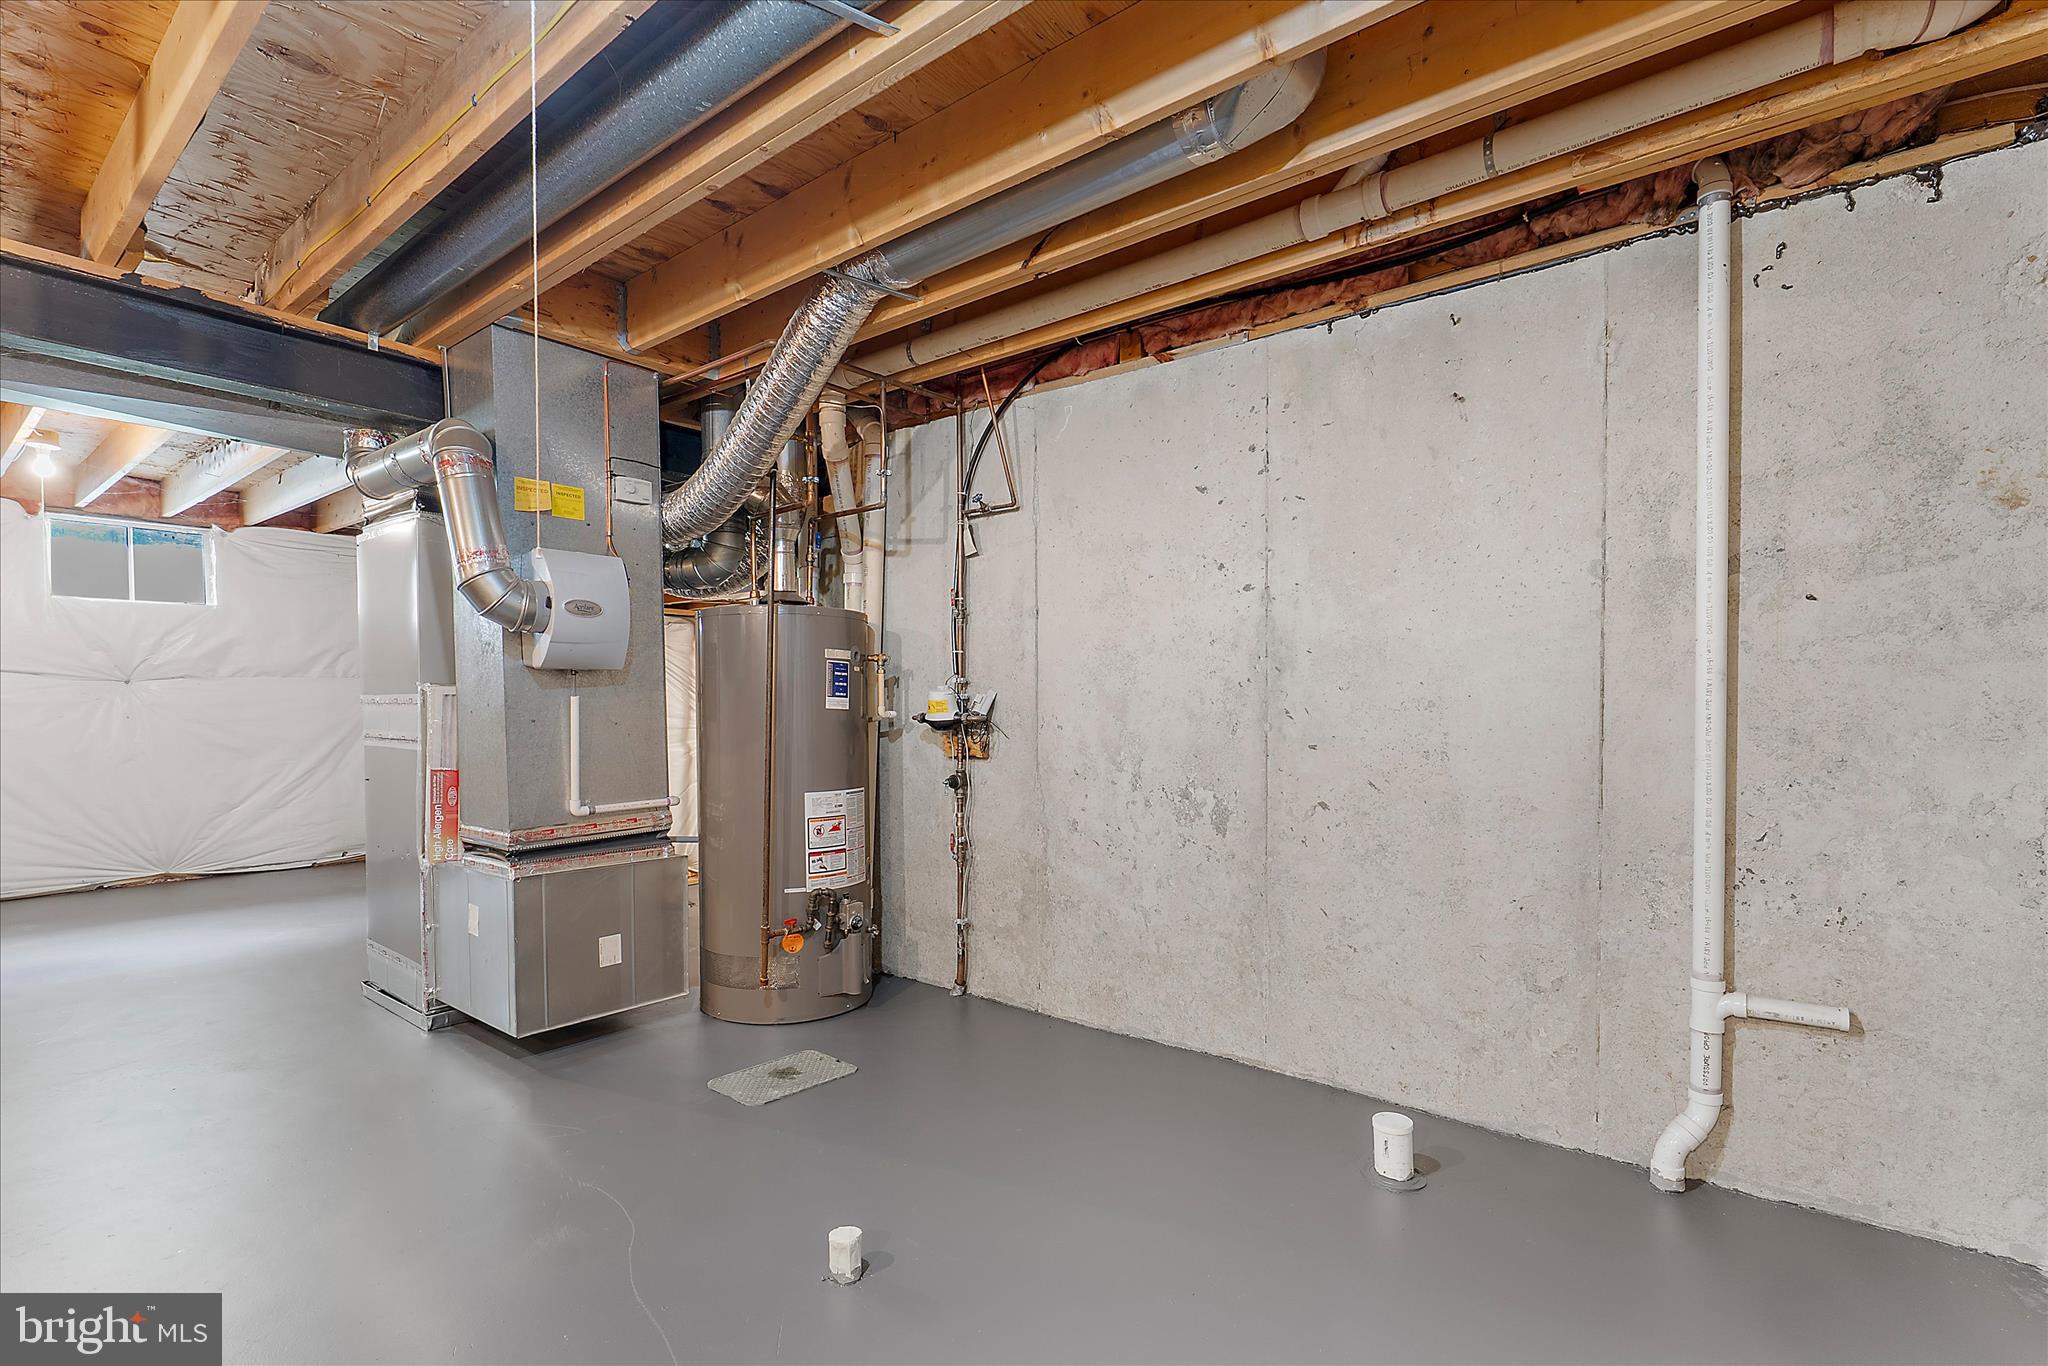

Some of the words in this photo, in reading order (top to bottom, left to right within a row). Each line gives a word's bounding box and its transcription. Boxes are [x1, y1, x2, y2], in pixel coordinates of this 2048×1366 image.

[516, 485, 549, 494] INSPECED
[556, 491, 581, 499] INSPECTED
[433, 804, 444, 840] Allergen
[433, 841, 443, 861] High
